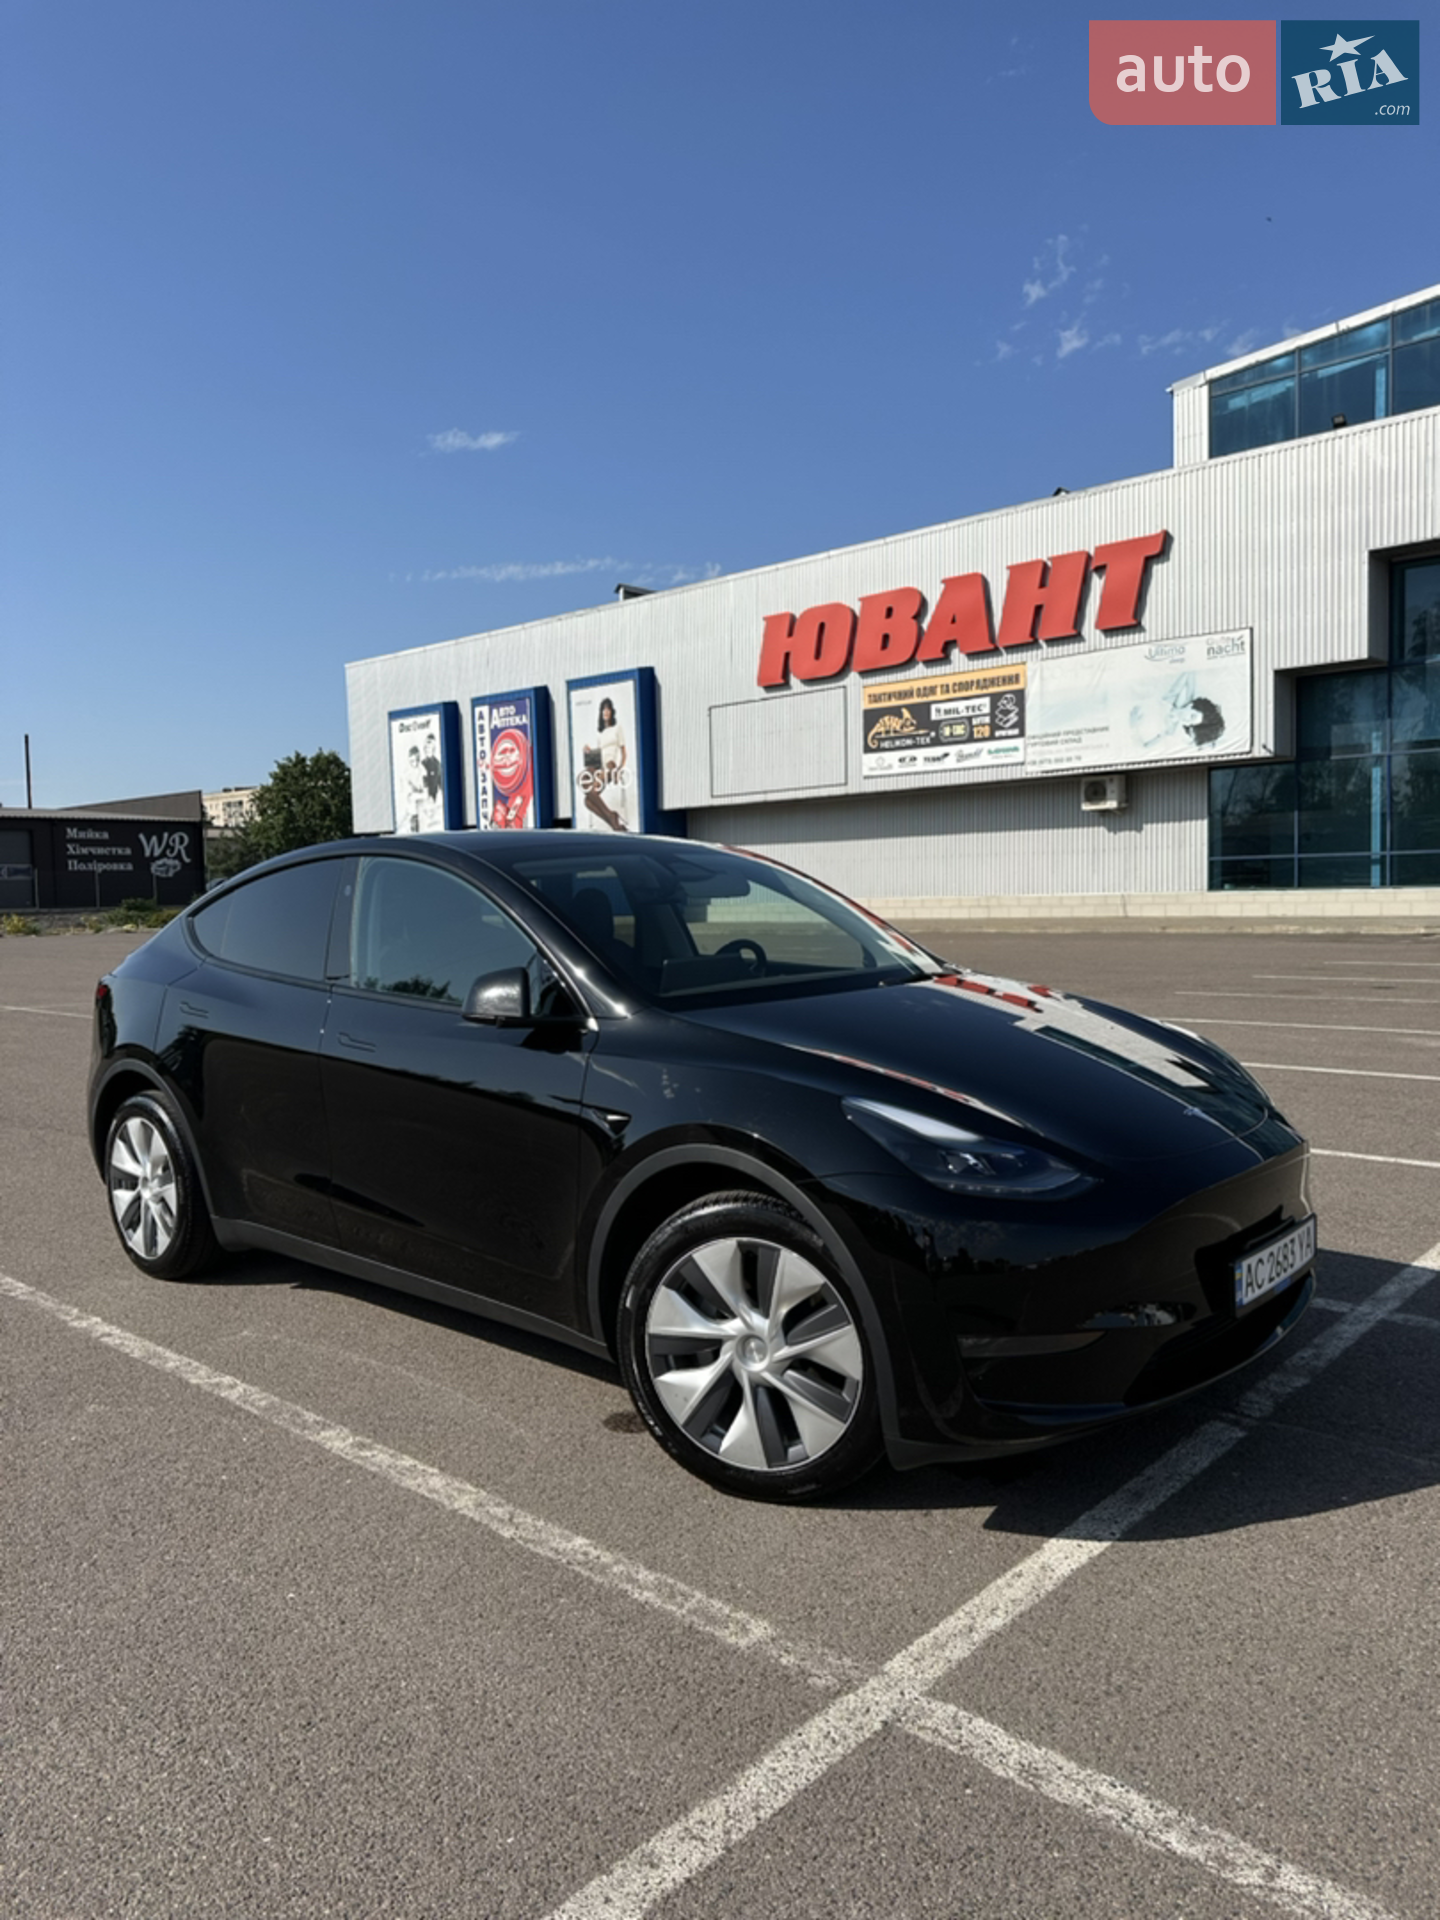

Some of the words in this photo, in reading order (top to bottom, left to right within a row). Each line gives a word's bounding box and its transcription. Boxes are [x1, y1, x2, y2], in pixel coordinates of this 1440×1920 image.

[756, 529, 1169, 689] ЮВАНТ
[1206, 637, 1245, 656] nacht
[867, 685, 915, 705] ТАКТИЧНИЙ
[915, 686, 938, 699] ОДЯГ
[940, 683, 950, 695] ТА
[952, 673, 1021, 694] СПОРЯДЖЕННЯ
[944, 702, 983, 717] MIL-TEC
[879, 735, 931, 750] HELIKON-TEX
[65, 827, 110, 840] Мийка
[66, 843, 132, 857] Хімчистка
[137, 831, 191, 863] WR
[67, 860, 134, 874] Поліровка
[1244, 1258, 1266, 1299] AC
[1266, 1237, 1297, 1284] 2683
[1296, 1225, 1314, 1262] YA
